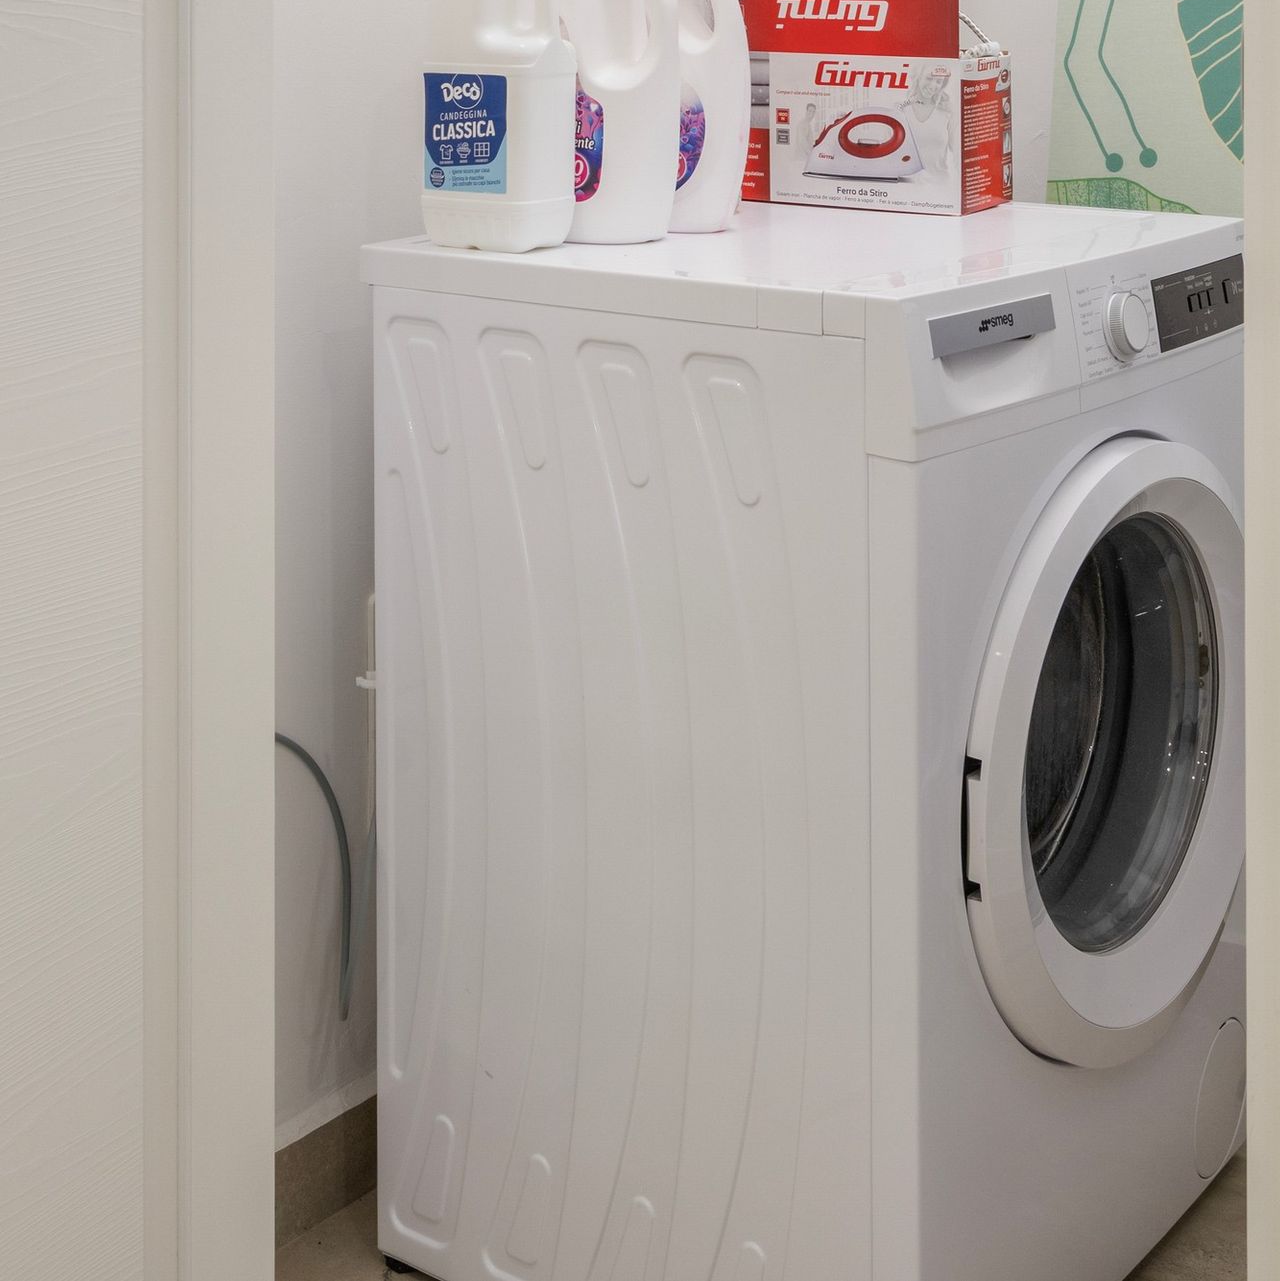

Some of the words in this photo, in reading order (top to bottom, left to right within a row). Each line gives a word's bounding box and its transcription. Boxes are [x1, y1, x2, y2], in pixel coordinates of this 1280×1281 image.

[978, 58, 1000, 71] Girmi
[814, 60, 909, 89] Girmi
[441, 82, 480, 102] Decò
[440, 109, 487, 121] CANDEGGINA
[433, 120, 496, 141] CLASSICA
[837, 187, 856, 195] Ferro
[858, 188, 868, 196] da
[870, 188, 888, 198] Stiro
[991, 314, 1014, 327] smeg
